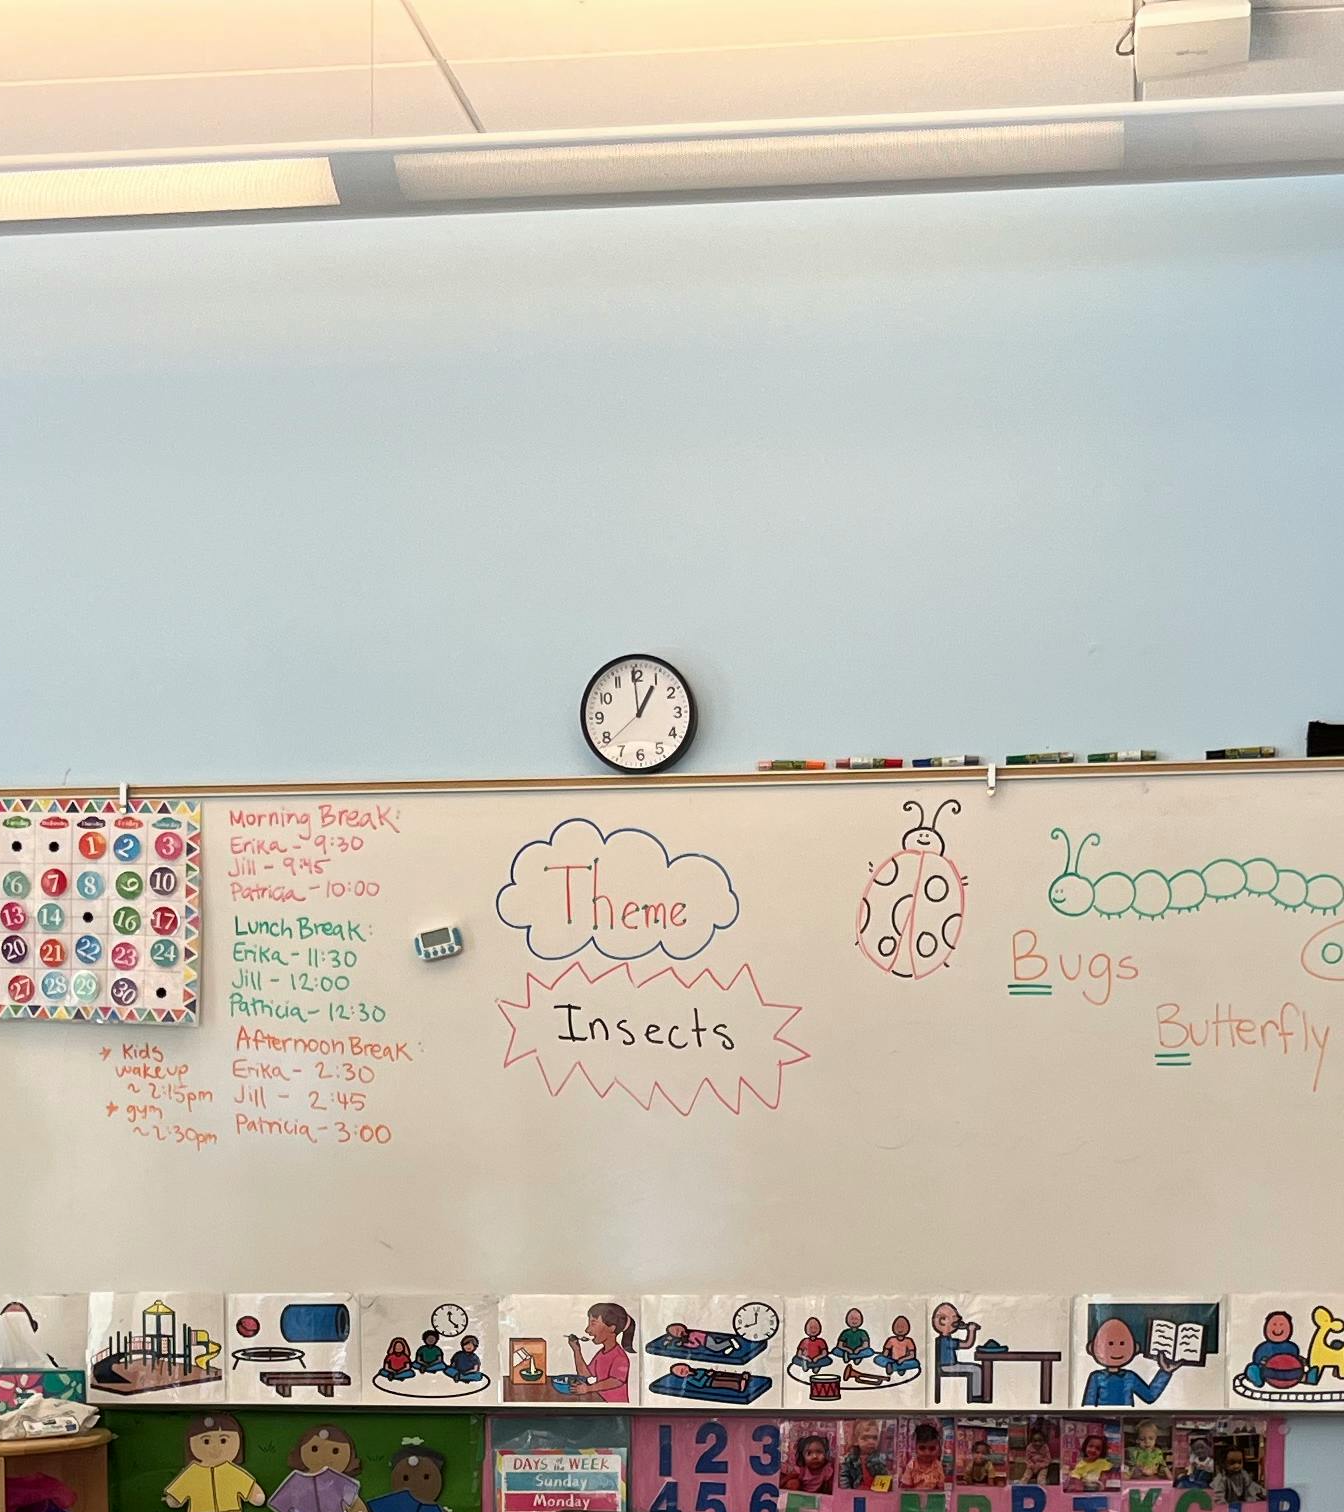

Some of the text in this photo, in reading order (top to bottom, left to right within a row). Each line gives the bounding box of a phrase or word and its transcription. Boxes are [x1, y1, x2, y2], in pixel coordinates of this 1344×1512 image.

[600, 692, 612, 705] 10
[667, 687, 675, 699] 2
[595, 712, 604, 724] 9
[674, 706, 682, 719] 3
[602, 732, 611, 744] 8
[668, 727, 677, 739] 4
[617, 745, 625, 757] 7
[636, 749, 645, 761] 6
[656, 742, 665, 755] 5
[229, 804, 400, 840] Morning Break:
[86, 836, 174, 857] 1 2 3
[230, 835, 364, 855] Erika 9:30
[228, 857, 331, 877] Jill 9:45
[10, 876, 23, 894] 6
[47, 873, 59, 892] 7
[85, 876, 96, 895] 8
[121, 877, 139, 891] 9
[153, 872, 176, 892] 10
[230, 880, 380, 902] Patricia 10:00
[543, 857, 687, 931] Theme
[3, 907, 24, 925] 13
[41, 907, 62, 925] 14
[114, 911, 136, 930] 16
[153, 912, 176, 930] 17
[234, 915, 374, 942] Lunch Break:
[6, 941, 27, 960] 20
[43, 944, 63, 962] 21
[76, 940, 100, 962] 22
[114, 949, 136, 966] 23
[153, 944, 176, 962] 24
[233, 942, 357, 968] Erika 11:30
[1010, 929, 1139, 1005] Bugs
[10, 978, 32, 1001] 27
[44, 976, 68, 993] 28
[74, 977, 96, 995] 29
[113, 983, 135, 1003] 30
[232, 968, 350, 992] Jill 12:00
[329, 1002, 386, 1023] 12:30
[554, 1003, 734, 1051] Insects
[236, 1025, 345, 1052] Afternoon
[1156, 1003, 1331, 1092] Butterfly
[122, 1043, 165, 1061] Kids
[232, 1059, 376, 1084] Erika 2:30
[233, 1086, 367, 1112] Jill 2:45
[126, 1106, 163, 1123] gym
[334, 1121, 392, 1145] 3:00
[658, 1421, 780, 1477] 1 2 3
[513, 1458, 548, 1470] DAYS
[569, 1458, 610, 1470] WEEK
[536, 1473, 588, 1491] Sunday
[533, 1494, 591, 1510] Monday
